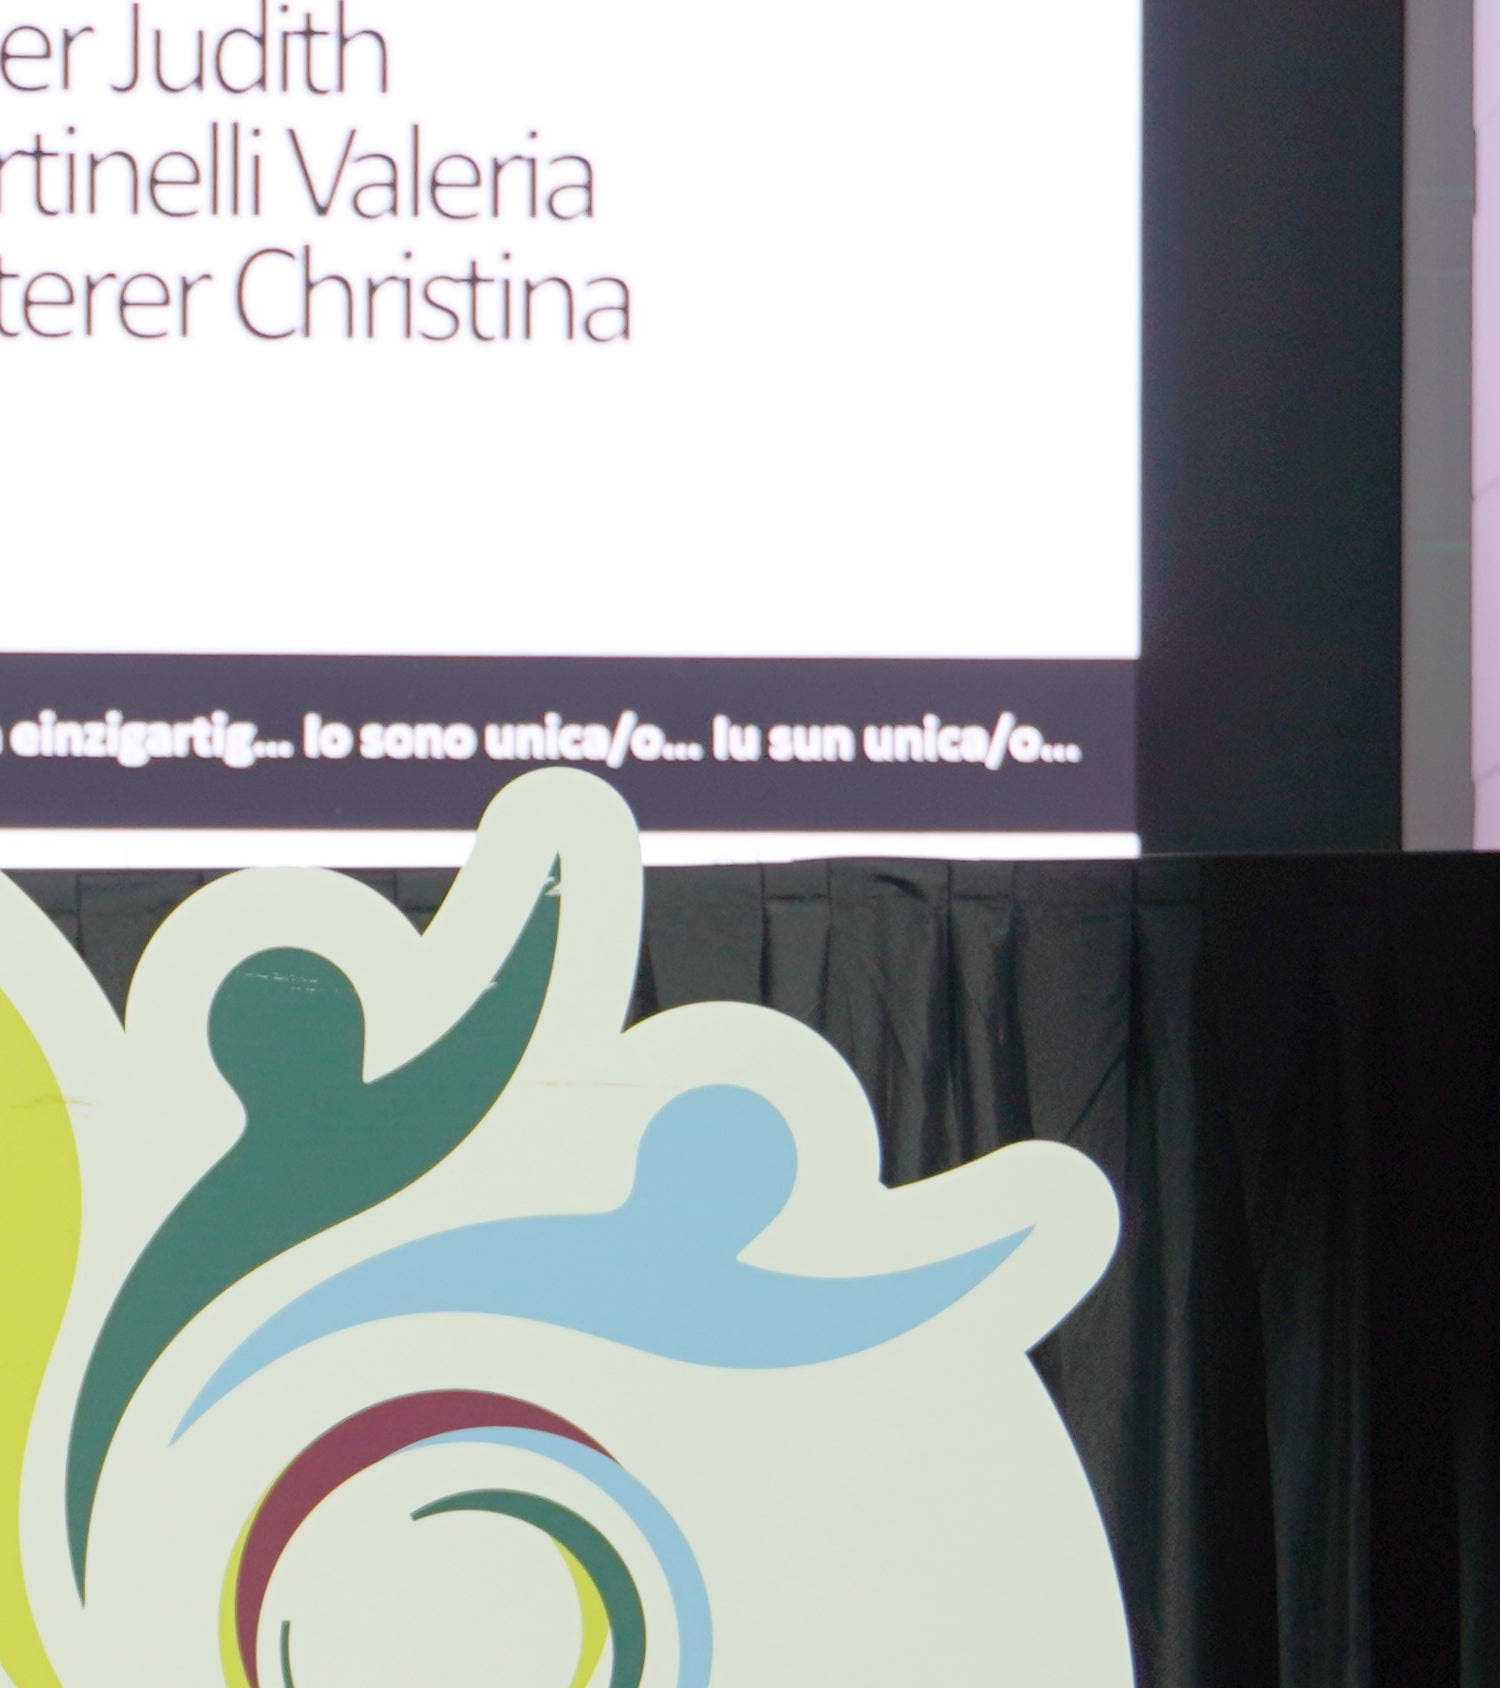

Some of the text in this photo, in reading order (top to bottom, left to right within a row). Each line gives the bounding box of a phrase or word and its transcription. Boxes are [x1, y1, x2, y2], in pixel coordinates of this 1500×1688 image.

[110, 0, 389, 95] Judith
[286, 122, 594, 221] Valeria
[235, 243, 631, 343] Christina
[10, 708, 294, 768] einzigartig...
[303, 712, 354, 759] Io
[359, 723, 478, 760] sono
[484, 710, 704, 769] unica/o...
[713, 714, 761, 762] Iu
[768, 724, 855, 762] sun
[863, 711, 1081, 771] unica/o...
